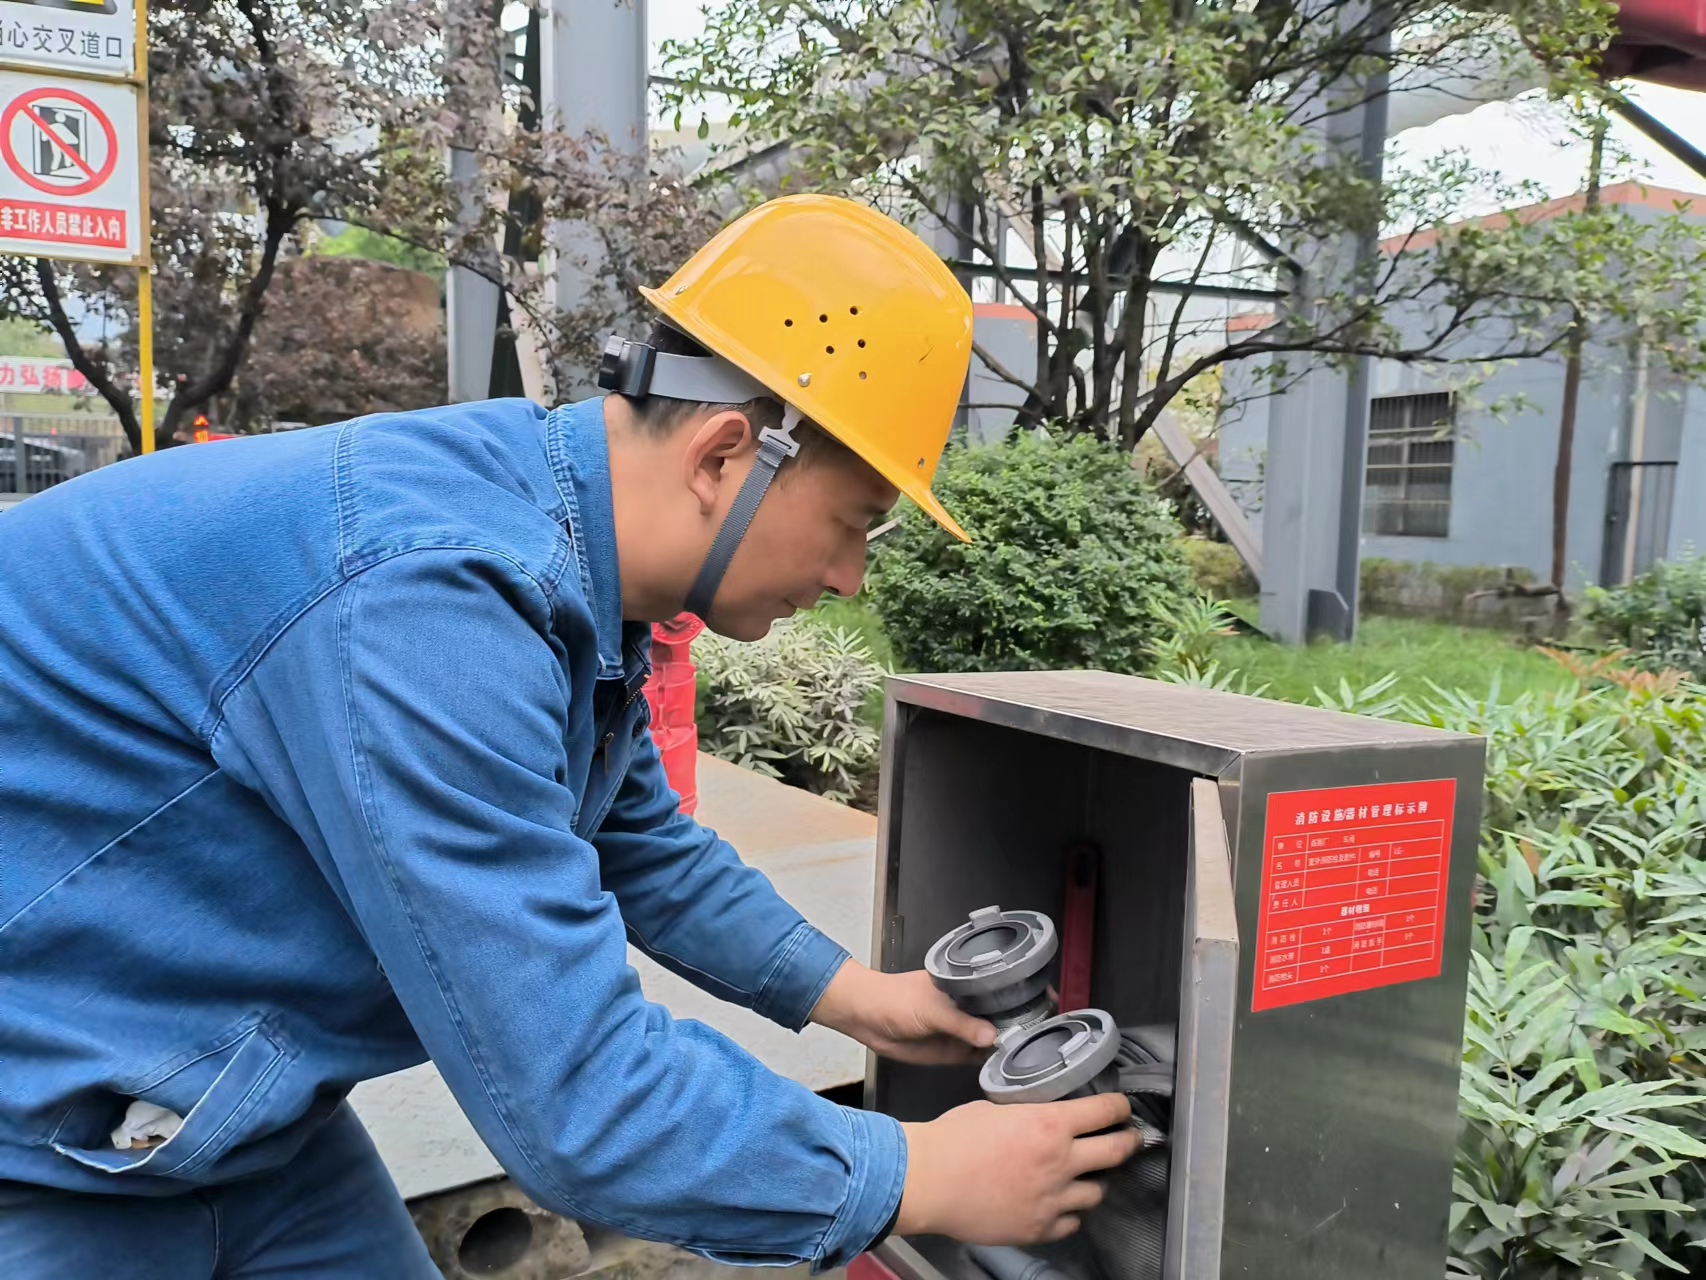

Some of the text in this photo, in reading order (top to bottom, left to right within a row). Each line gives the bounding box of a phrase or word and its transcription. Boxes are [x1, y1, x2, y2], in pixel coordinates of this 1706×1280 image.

[0, 21, 122, 59] 心交叉道口
[0, 206, 121, 241] 非工作人员禁止入内
